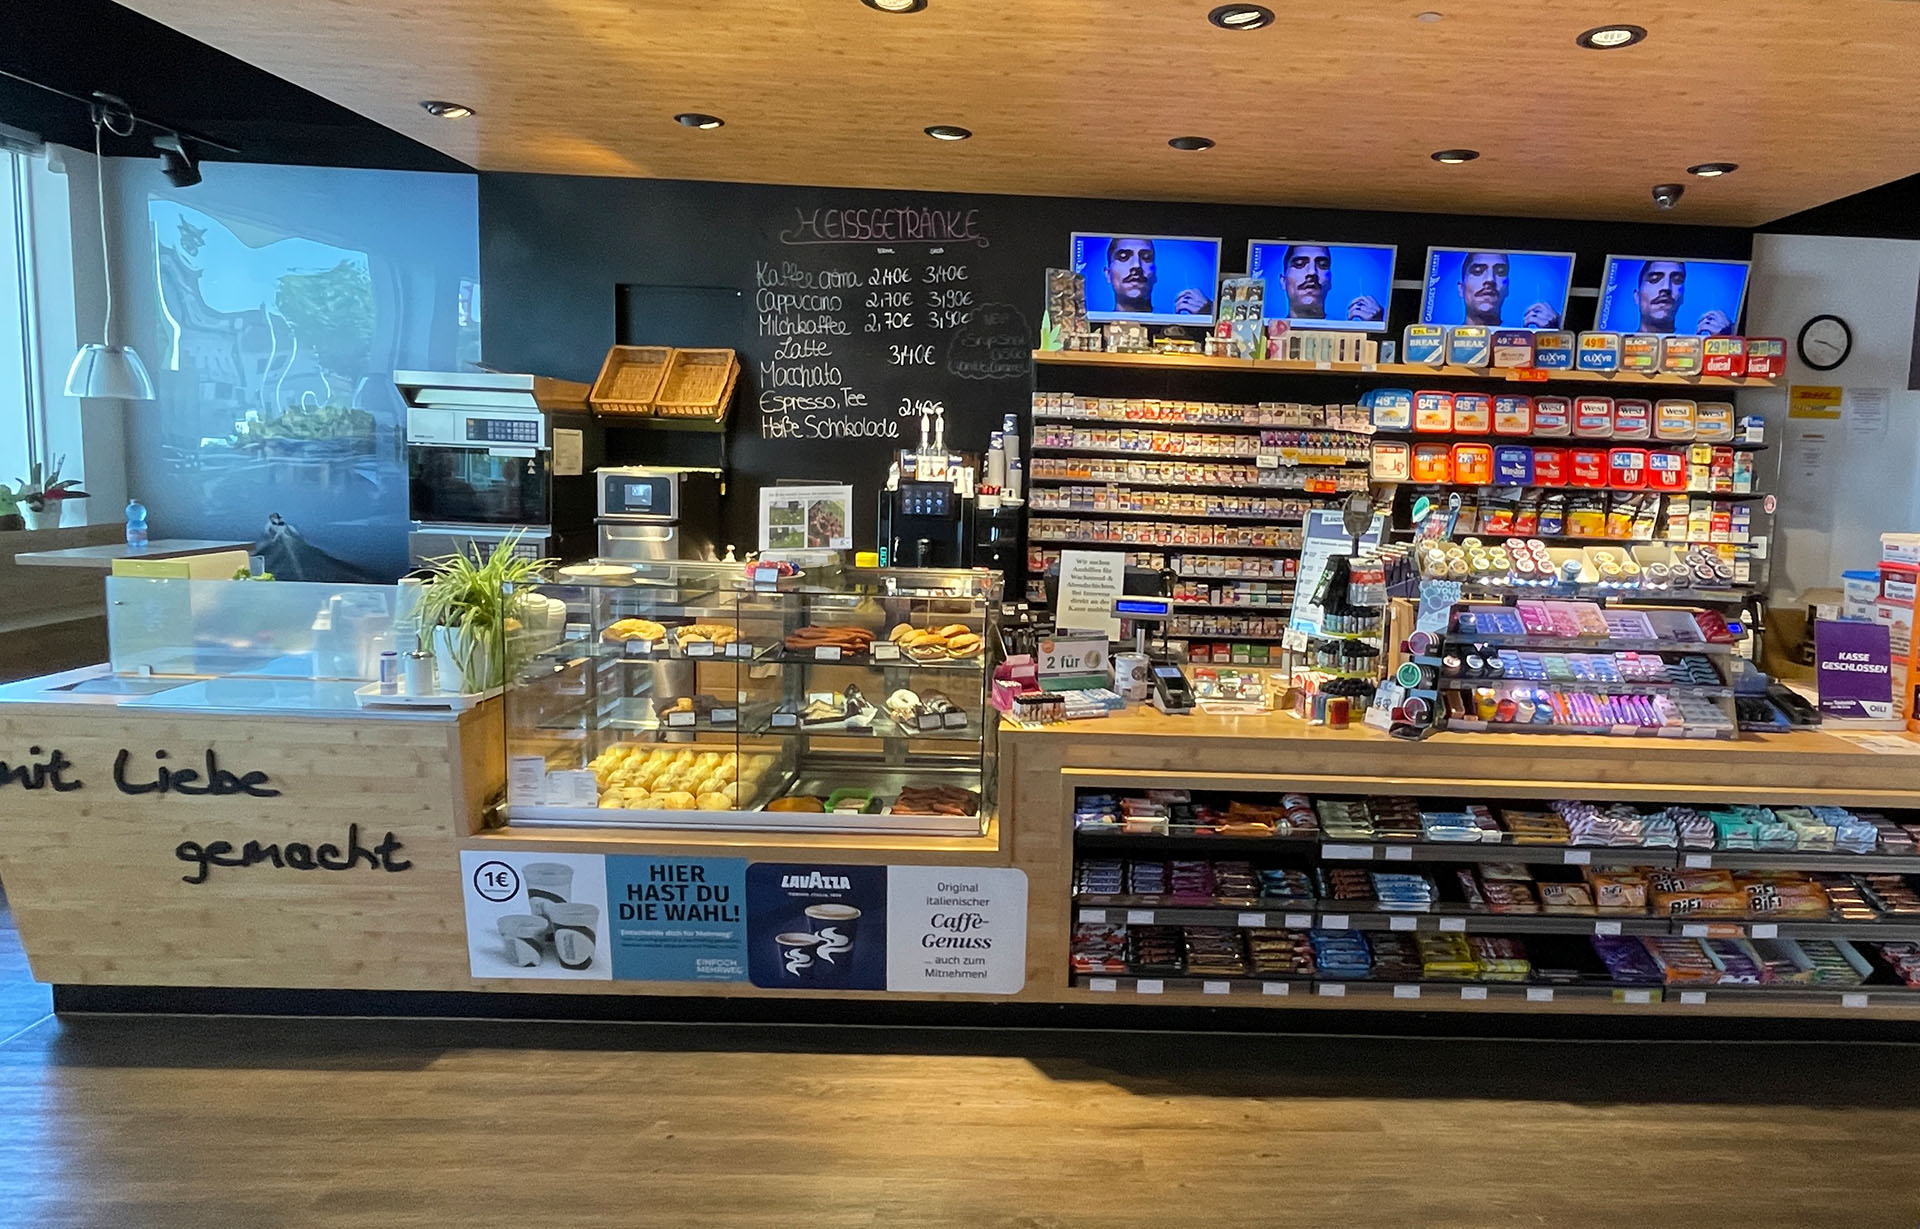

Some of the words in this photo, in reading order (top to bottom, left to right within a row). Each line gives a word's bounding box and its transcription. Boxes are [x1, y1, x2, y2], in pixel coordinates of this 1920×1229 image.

[795, 207, 980, 240] HEISSGETRÄNKE
[756, 287, 843, 315] Cappuccino
[759, 313, 852, 336] Milchkaffee
[774, 336, 833, 360] Latte
[760, 360, 842, 389] Macchiato
[840, 387, 868, 407] Tee
[1539, 403, 1562, 411] West
[1582, 404, 1605, 412] West
[1620, 406, 1642, 414] West
[1664, 407, 1687, 415] West
[1700, 409, 1724, 417] West
[1046, 656, 1056, 669] 2
[1060, 654, 1081, 669] für
[1838, 652, 1870, 662] KASSE
[1821, 661, 1888, 674] GESCHLOSSEN
[114, 749, 282, 797] Liebe
[176, 823, 412, 885] gemacht
[484, 871, 509, 888] 1€
[649, 865, 705, 882] HIER
[781, 871, 851, 890] LAVAZZA
[626, 884, 689, 902] HAST
[697, 885, 730, 902] DU
[937, 882, 979, 894] Original
[926, 896, 990, 907] italienischer
[619, 903, 662, 921] DIE
[665, 904, 740, 922] WAHL!
[930, 912, 990, 933] Caffè-
[921, 933, 993, 950] Genuss
[934, 955, 960, 965] auch
[963, 957, 986, 965] zum
